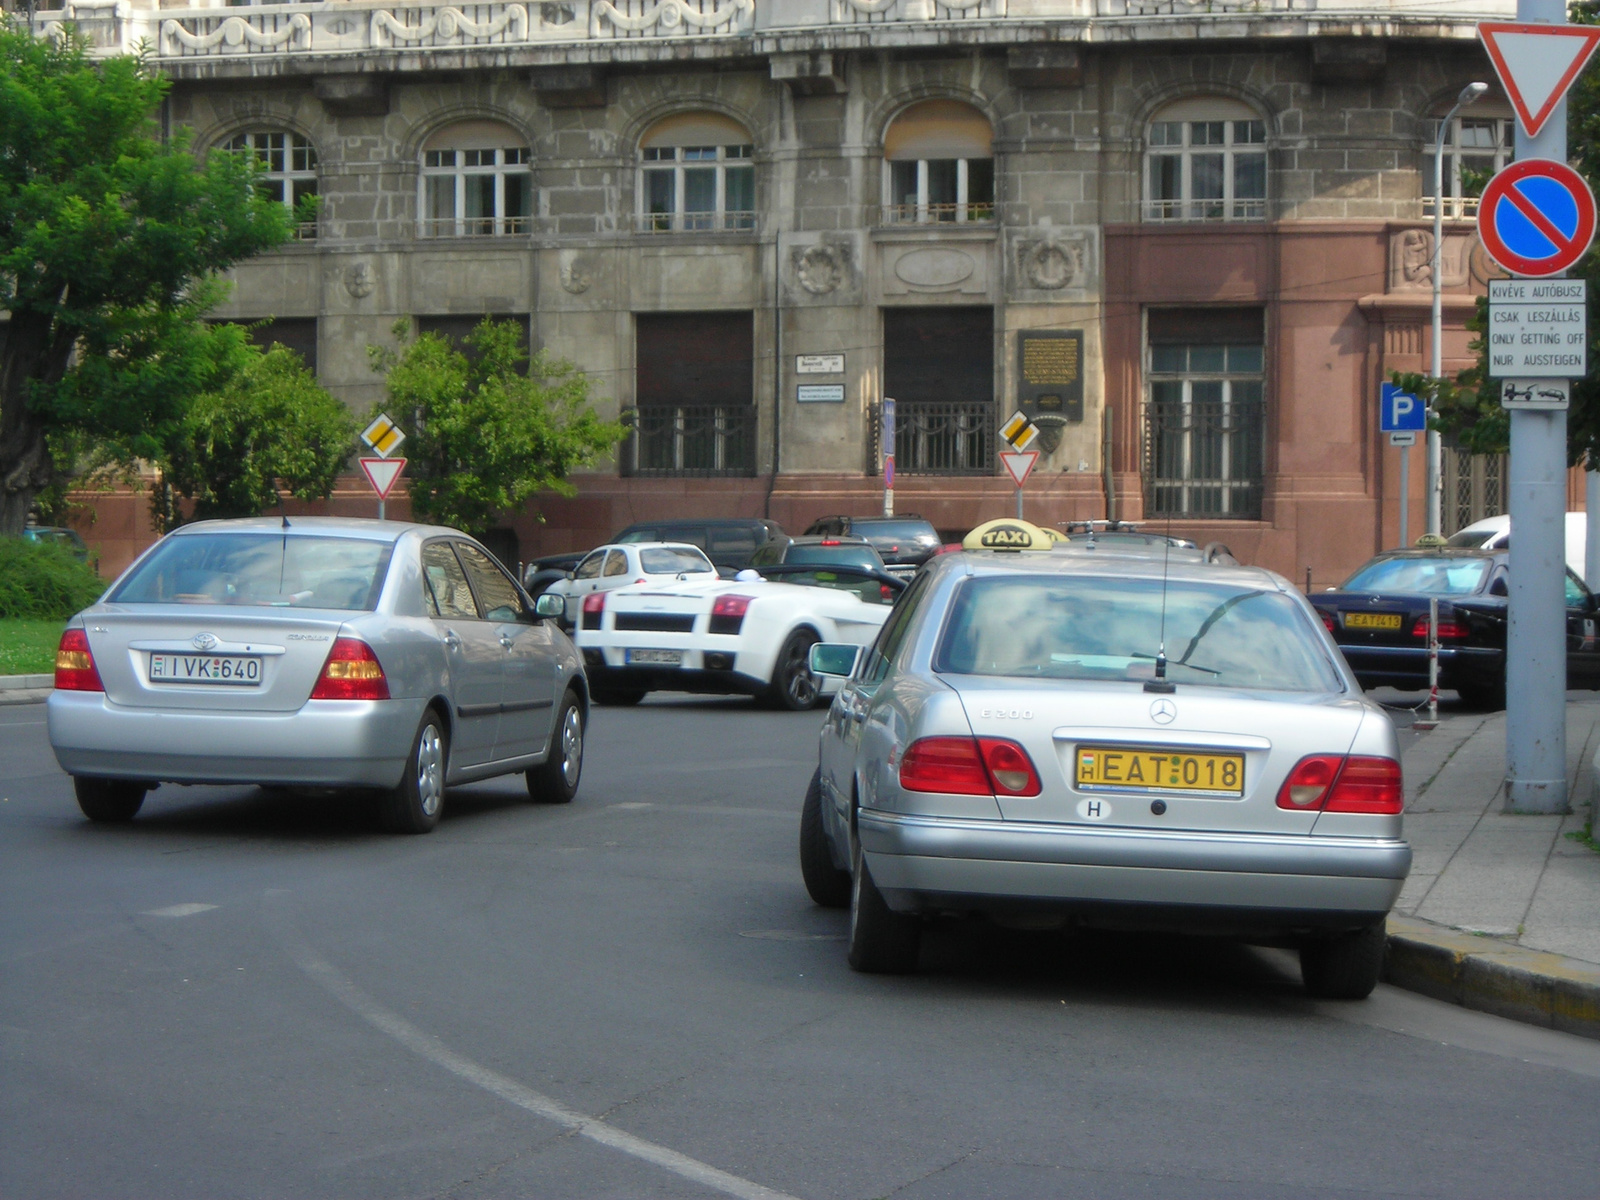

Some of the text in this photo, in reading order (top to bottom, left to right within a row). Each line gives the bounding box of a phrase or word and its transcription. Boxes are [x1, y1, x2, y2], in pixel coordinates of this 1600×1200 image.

[1492, 283, 1582, 298] KIVÉVE AUTÓBUSZ
[1494, 308, 1580, 323] CSAK LESZÁLLÁS
[1492, 333, 1584, 344] ONLY GETTING OFF
[1493, 355, 1582, 366] NUR AUSSTEIGEN
[1392, 396, 1414, 426] P
[983, 530, 1029, 544] TAXI
[1087, 801, 1101, 817] H
